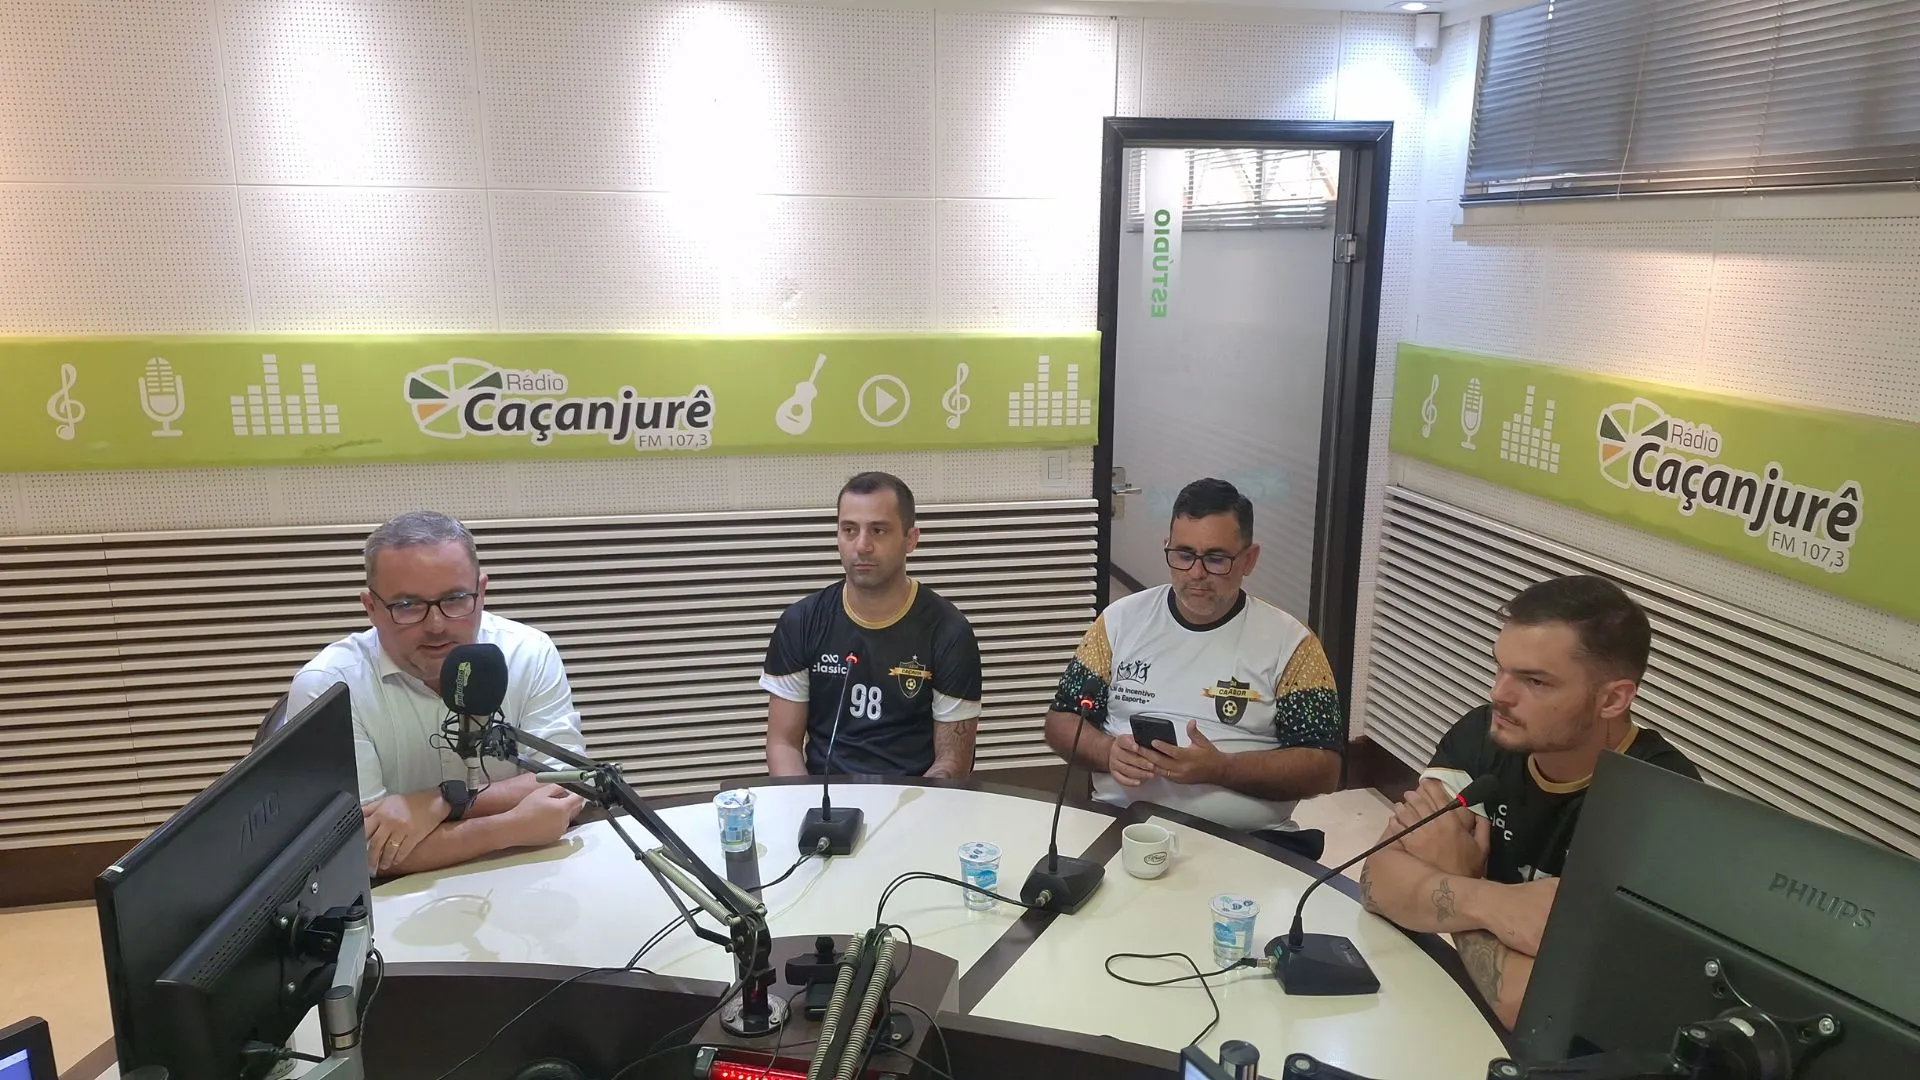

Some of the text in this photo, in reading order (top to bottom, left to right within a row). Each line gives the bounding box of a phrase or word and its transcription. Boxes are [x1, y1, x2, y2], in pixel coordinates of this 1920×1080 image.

[506, 373, 564, 391] Rádio
[464, 389, 712, 442] Caçanjurê
[638, 434, 708, 448] FM 107,3
[1671, 423, 1719, 453] Rádio
[1632, 442, 1860, 542] Caçanjurê
[1771, 531, 1846, 568] FM 107,3
[850, 683, 882, 720] 98
[1121, 694, 1146, 705] Esporte
[1125, 687, 1156, 698] Incentivo
[1768, 872, 1876, 929] PHILIPS
